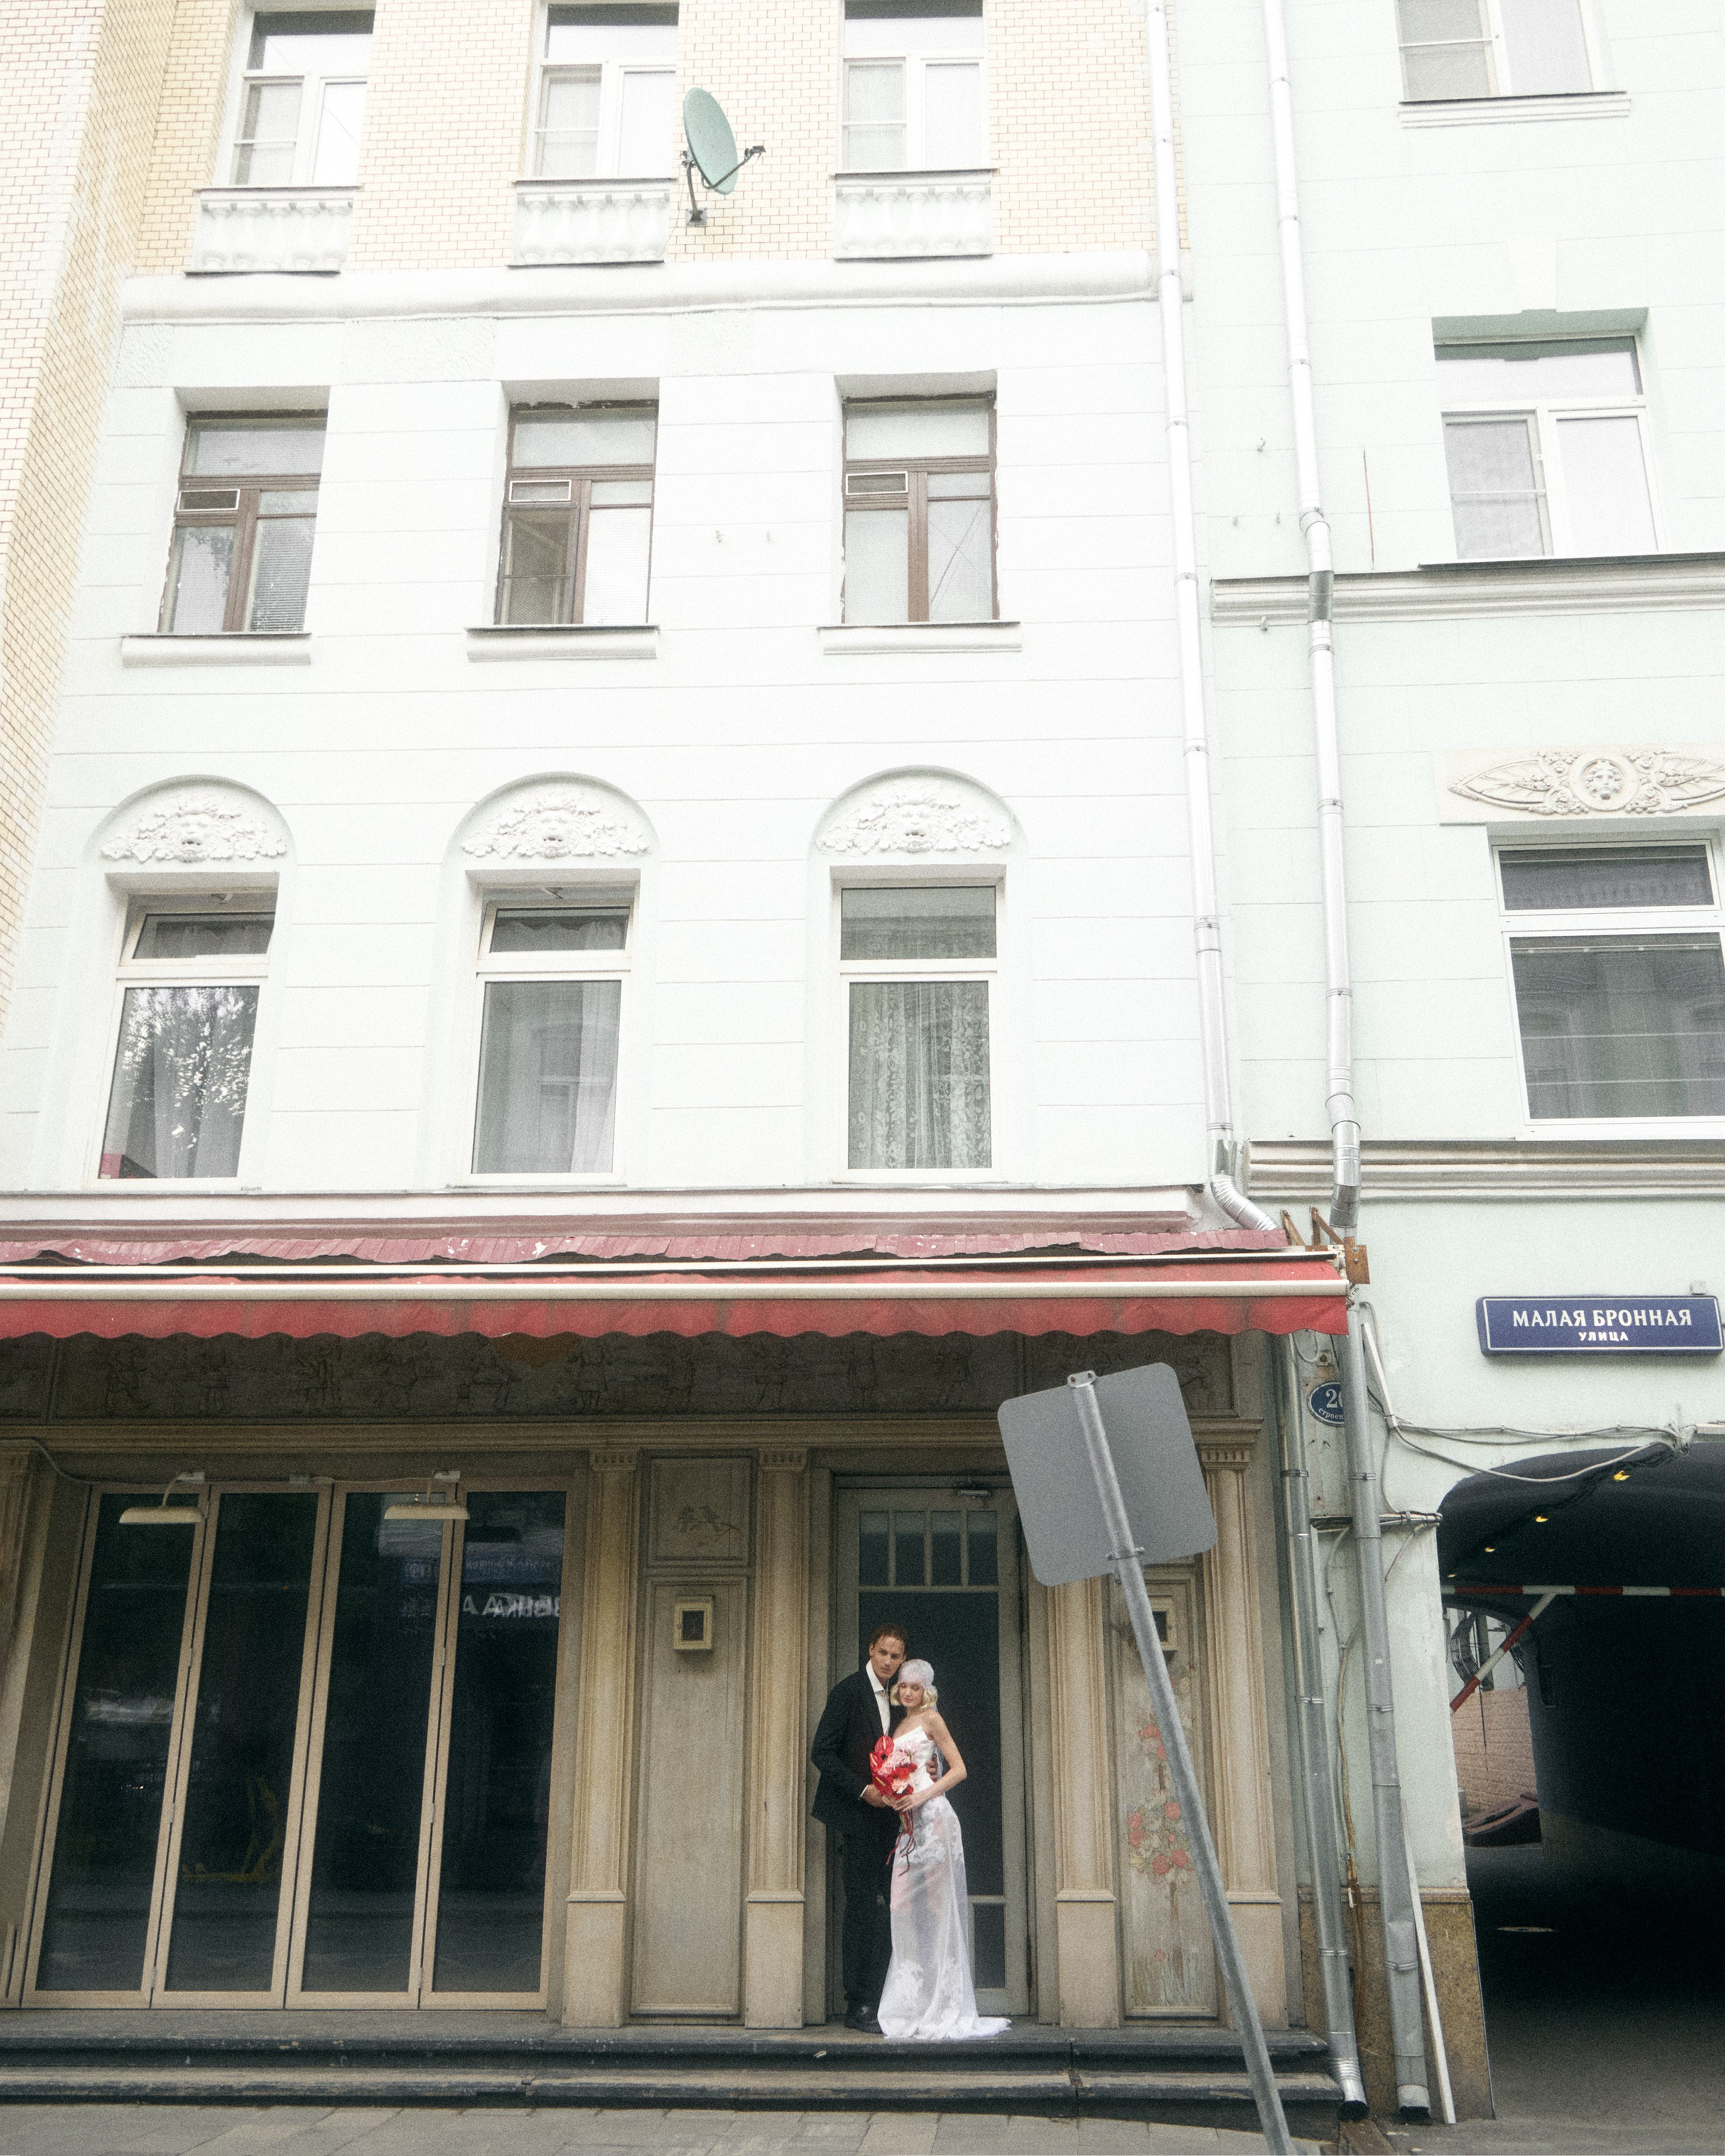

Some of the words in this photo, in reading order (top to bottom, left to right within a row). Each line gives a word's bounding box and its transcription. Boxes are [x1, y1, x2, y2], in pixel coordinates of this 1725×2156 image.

[1513, 1310, 1587, 1327] МАЛАЯ
[1593, 1309, 1693, 1327] БРОННАЯ
[1578, 1331, 1629, 1341] УЛИЦА
[1318, 1408, 1344, 1420] строен
